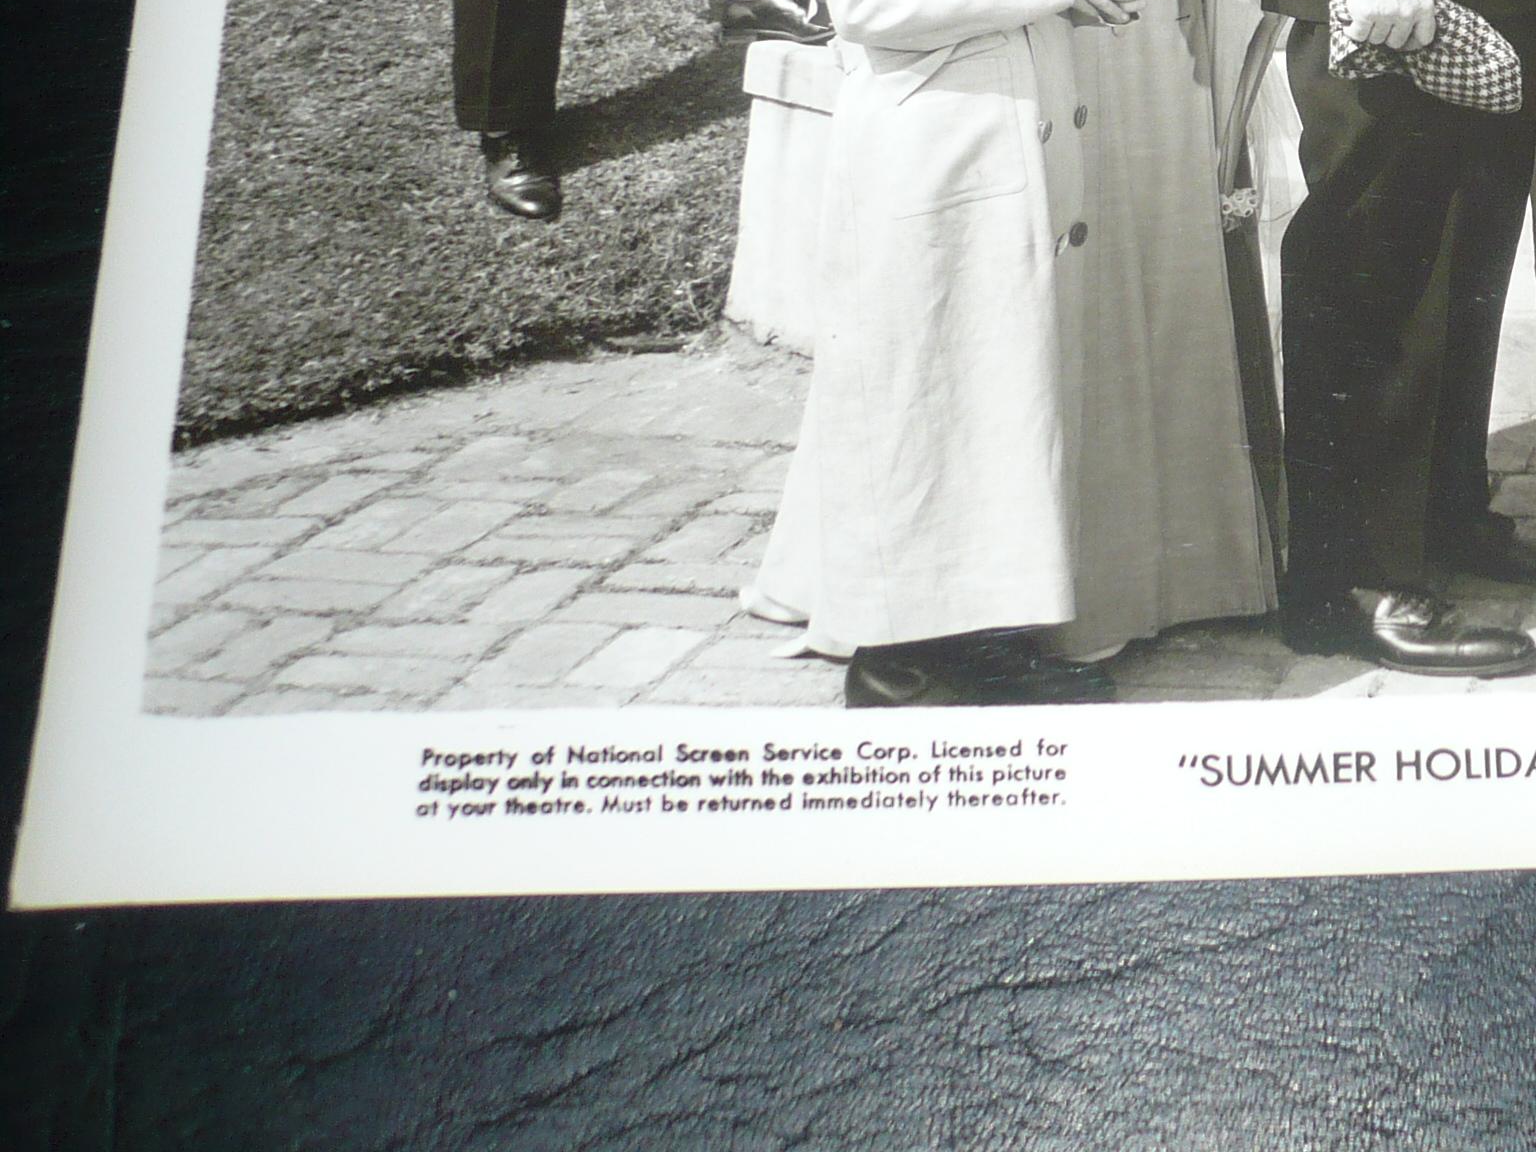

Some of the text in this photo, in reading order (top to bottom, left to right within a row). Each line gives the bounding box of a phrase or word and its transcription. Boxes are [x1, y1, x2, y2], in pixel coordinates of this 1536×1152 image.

[420, 737, 1069, 771] Property of National Screen Service Corp. Licensed for
[417, 763, 1067, 797] display only in connection with the exhibition of this picture
[415, 786, 1066, 821] at your theatre. Must be returned immediately thereafter.
